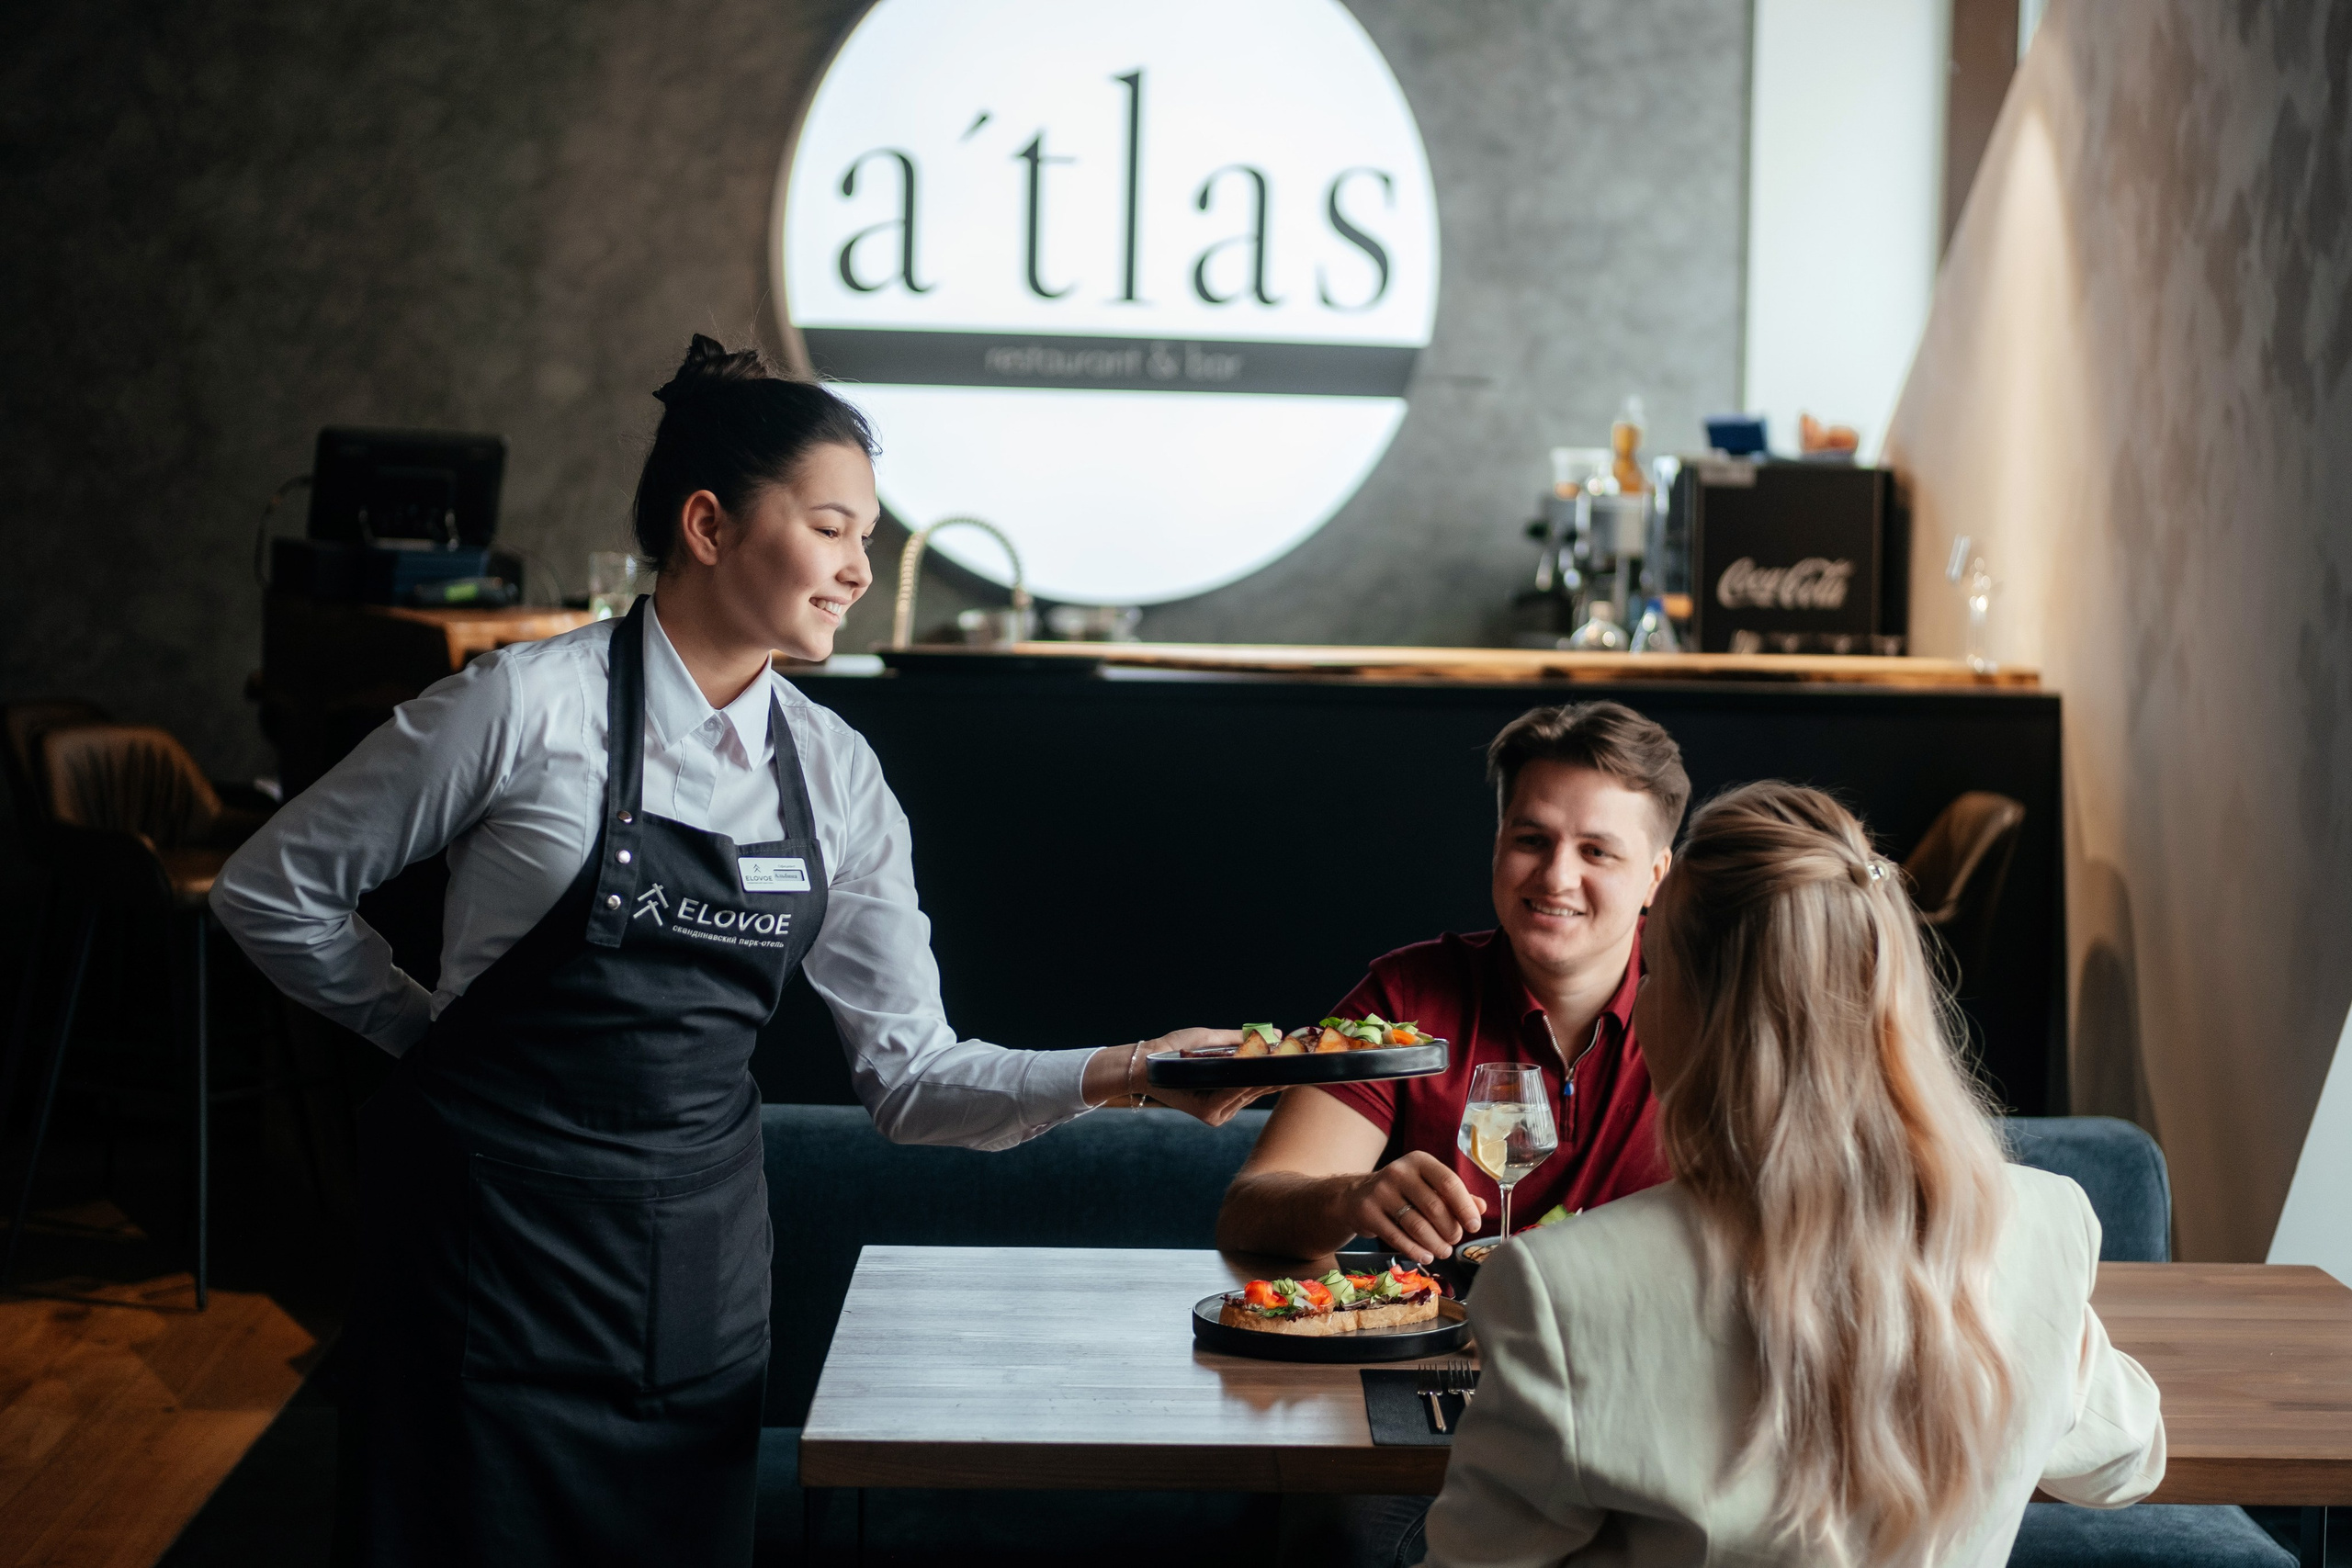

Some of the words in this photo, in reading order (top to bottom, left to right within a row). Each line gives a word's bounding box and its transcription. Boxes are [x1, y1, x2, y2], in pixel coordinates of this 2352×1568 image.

[985, 345, 1139, 378] restaurant
[1147, 344, 1179, 380] &
[1185, 344, 1243, 381] bar
[677, 897, 791, 935] ELOVOE
